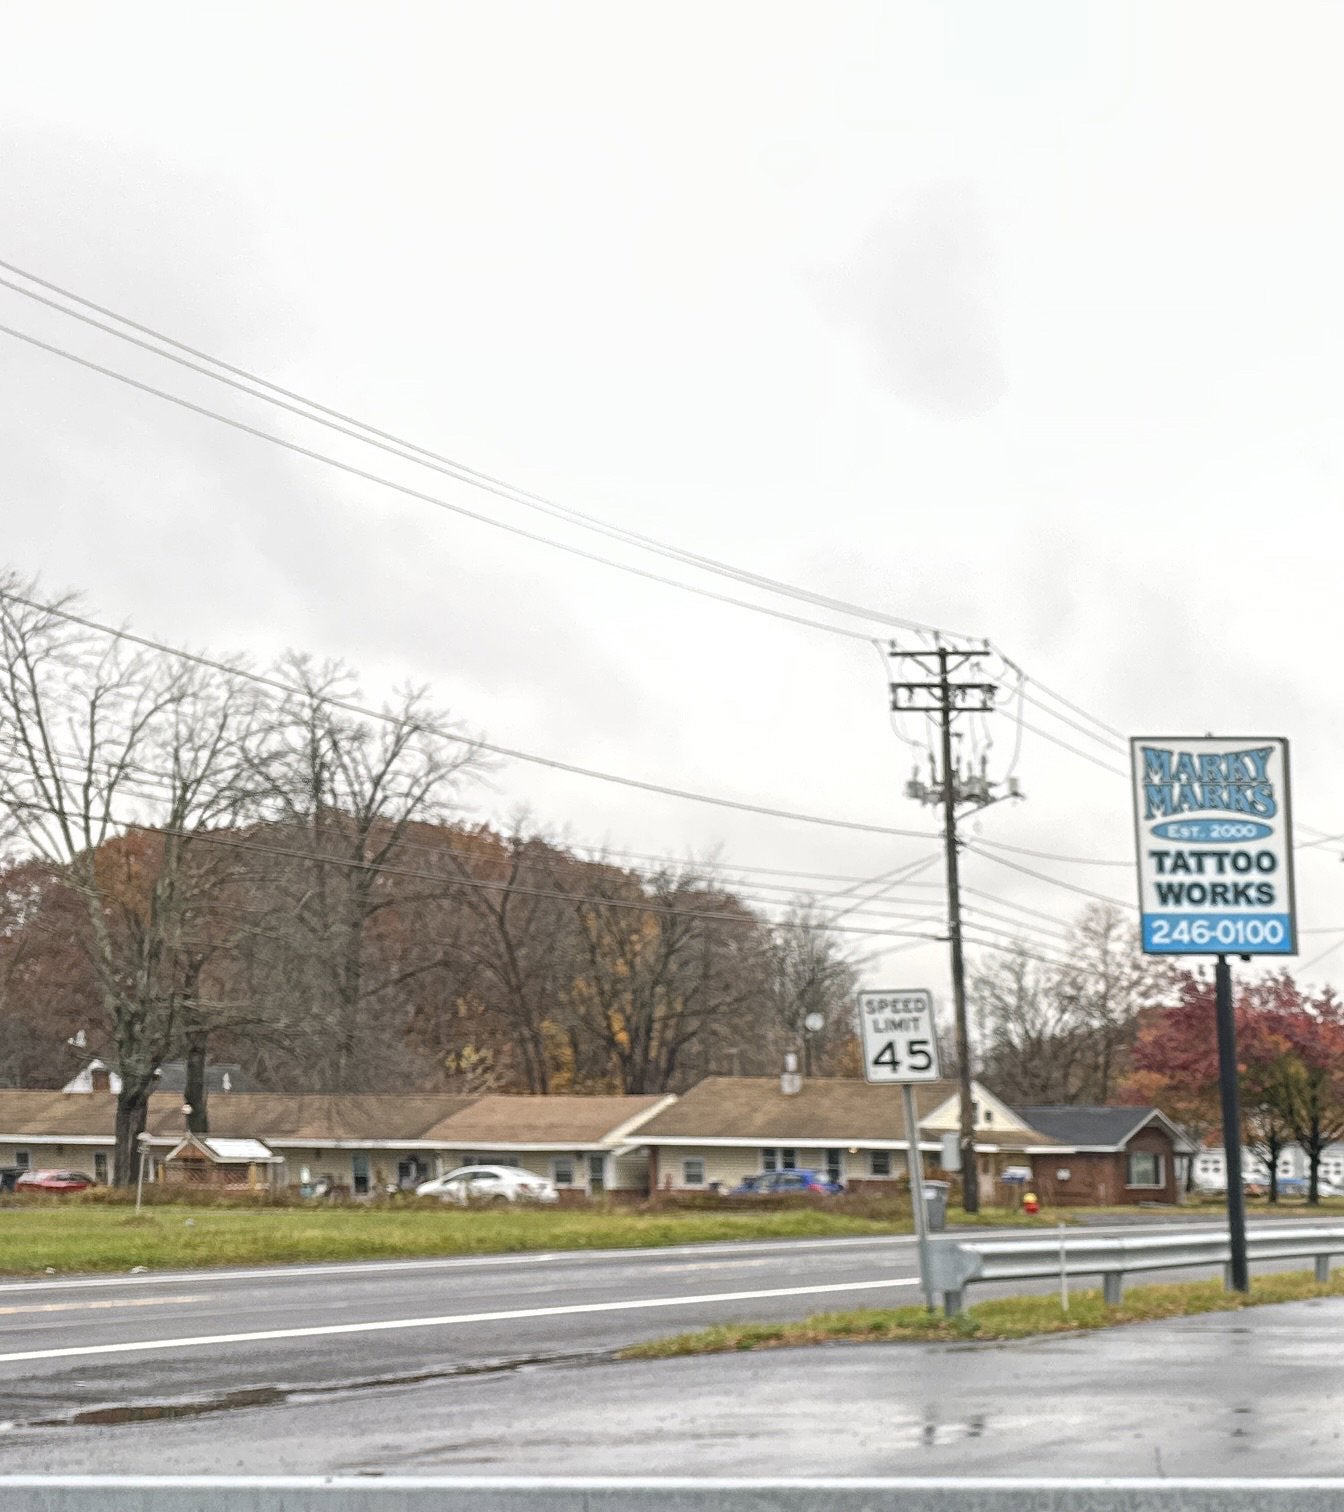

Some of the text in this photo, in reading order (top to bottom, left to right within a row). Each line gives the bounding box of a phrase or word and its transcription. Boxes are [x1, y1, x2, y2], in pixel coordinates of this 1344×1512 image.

[1140, 746, 1275, 783] MARKY
[1143, 783, 1277, 820] MARKS
[1210, 825, 1256, 838] 2000
[1149, 850, 1277, 875] TATTOO
[1154, 882, 1275, 906] WORKS
[1151, 919, 1285, 945] 246-0100
[865, 998, 927, 1014] SPEED
[873, 1017, 919, 1033] LIMIT
[873, 1041, 931, 1072] 45
